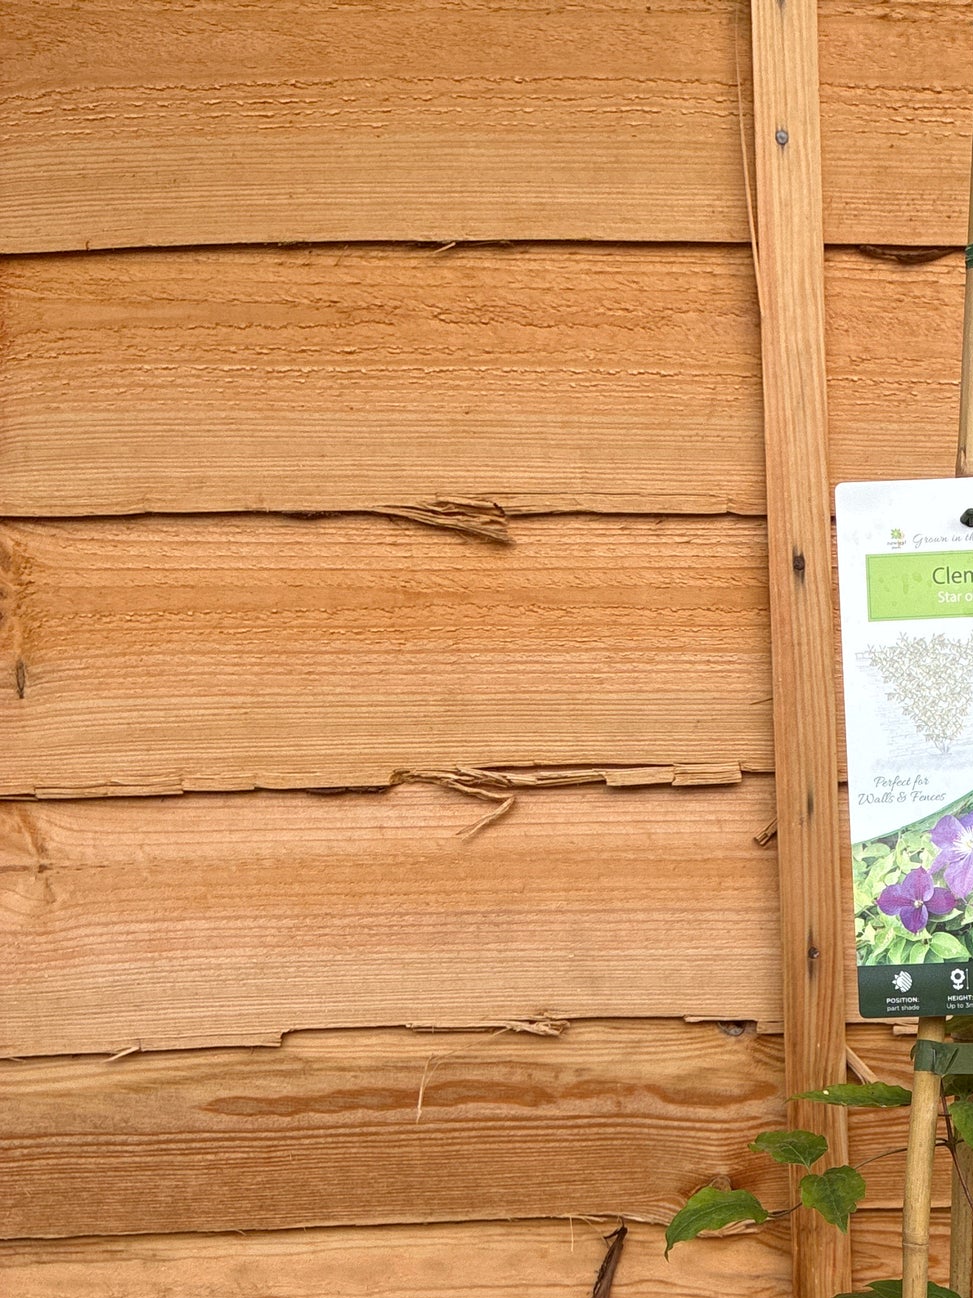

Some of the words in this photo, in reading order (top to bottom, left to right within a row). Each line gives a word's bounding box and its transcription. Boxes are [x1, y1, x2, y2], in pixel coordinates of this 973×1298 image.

[913, 534, 948, 549] Grown
[938, 590, 961, 603] Star
[873, 775, 911, 792] Perfect
[912, 774, 929, 790] for
[858, 791, 894, 805] Walls
[896, 791, 907, 803] &
[910, 790, 947, 802] Fences
